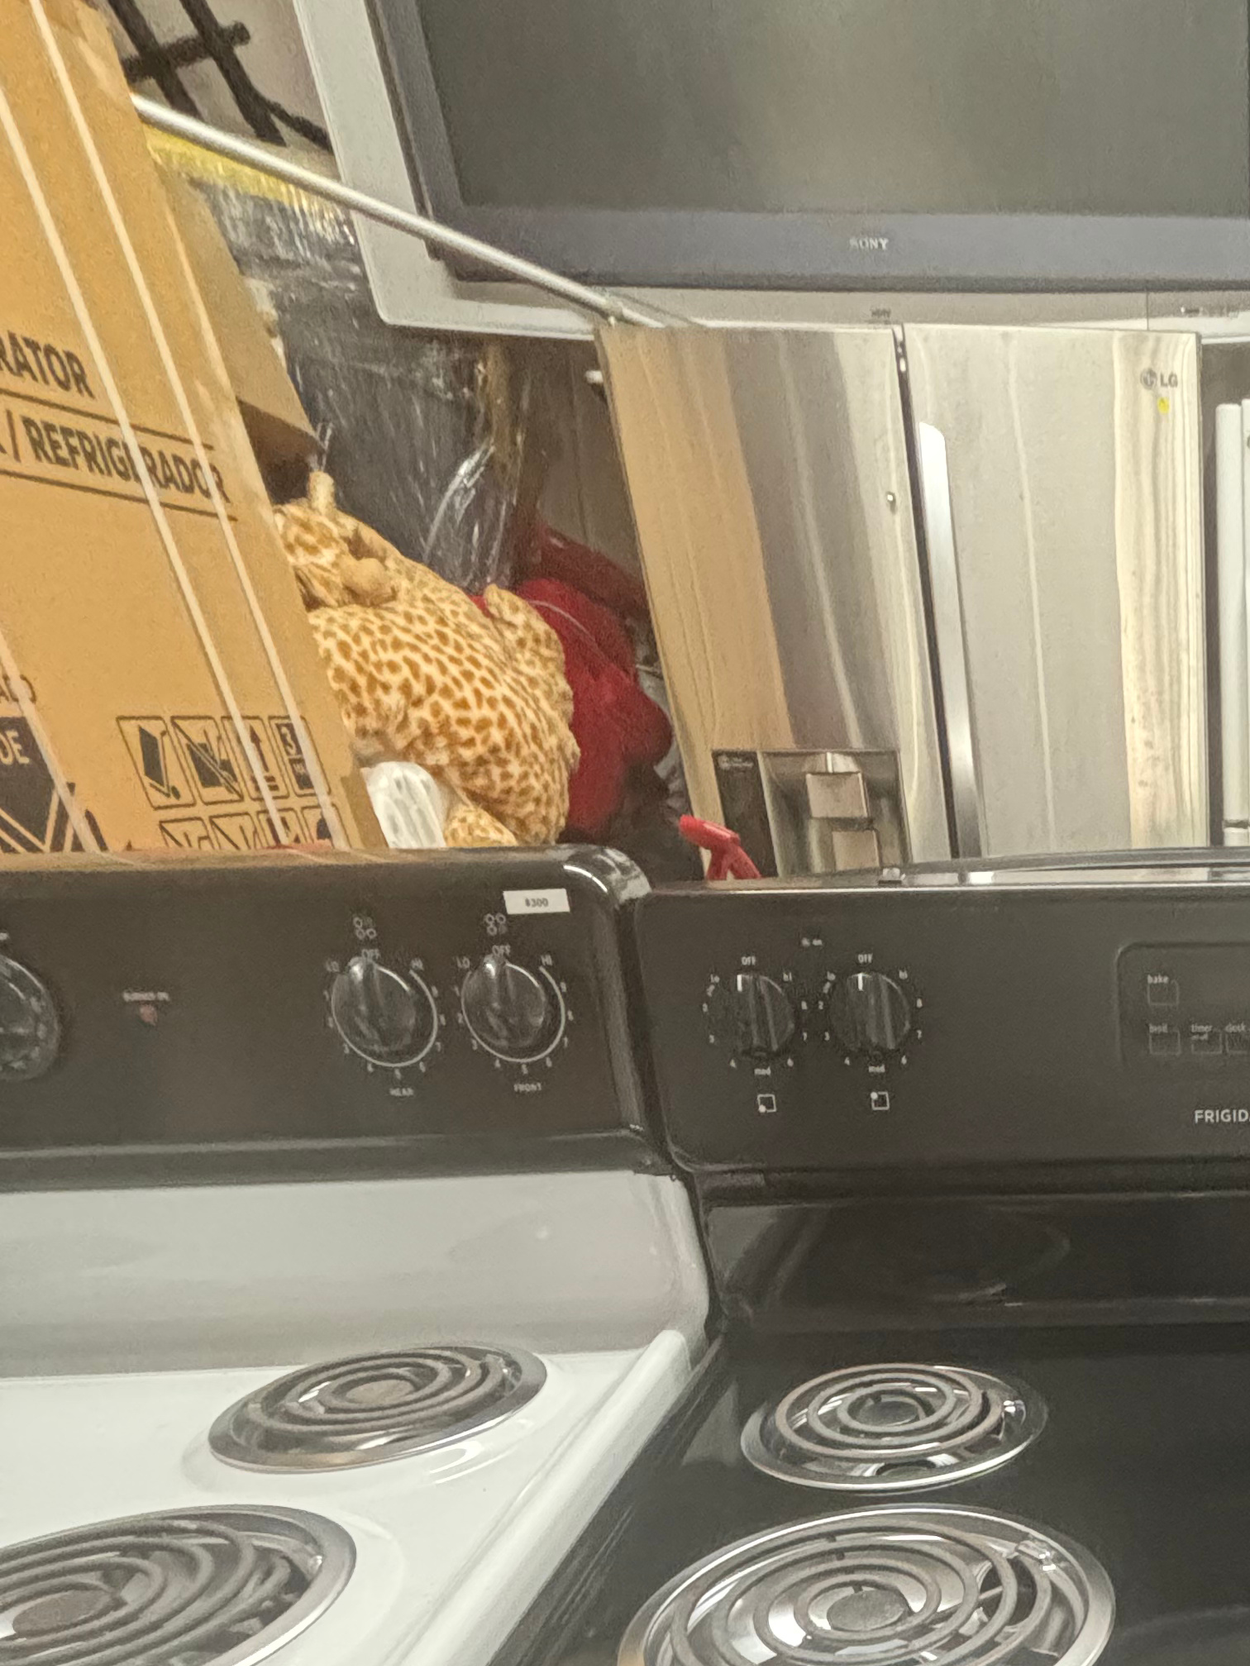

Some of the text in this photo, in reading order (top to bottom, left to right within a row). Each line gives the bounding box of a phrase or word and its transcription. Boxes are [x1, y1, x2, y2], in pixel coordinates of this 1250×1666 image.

[849, 237, 889, 251] SONY
[1160, 373, 1178, 389] LG
[525, 897, 549, 908] $300
[741, 955, 756, 966] OFF
[858, 953, 873, 964] OFF
[1147, 974, 1169, 984] bake
[1191, 1023, 1213, 1034] timer
[754, 1066, 771, 1076] med
